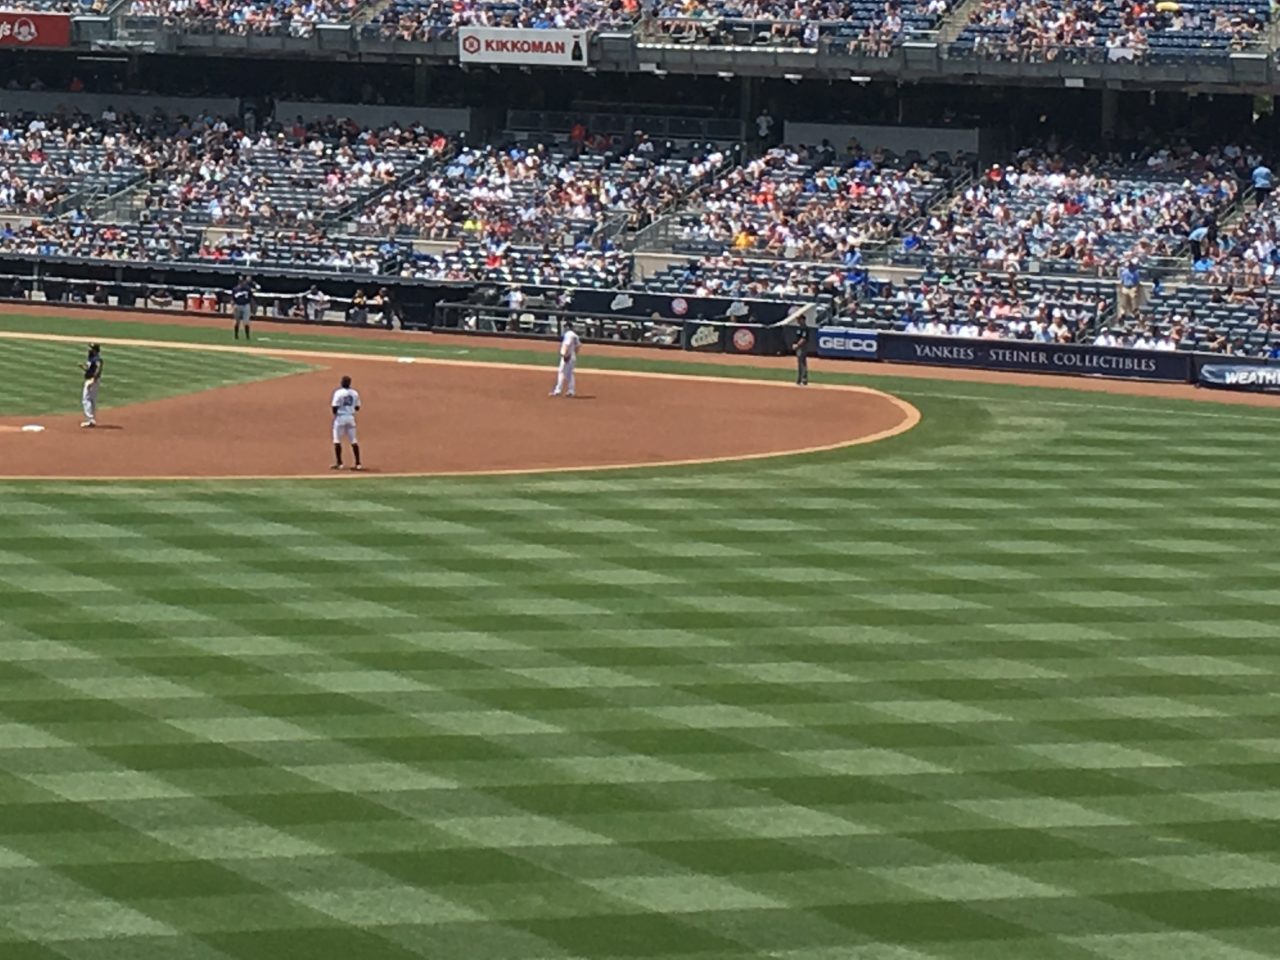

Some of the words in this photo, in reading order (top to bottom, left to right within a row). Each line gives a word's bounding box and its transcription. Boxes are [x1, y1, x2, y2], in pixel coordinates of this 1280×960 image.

[485, 39, 565, 54] KIKKOMAN
[819, 336, 878, 352] GEICO
[914, 344, 975, 360] YANKEES
[989, 348, 1048, 364] STEINER
[1053, 352, 1156, 372] COLLECTIBLES
